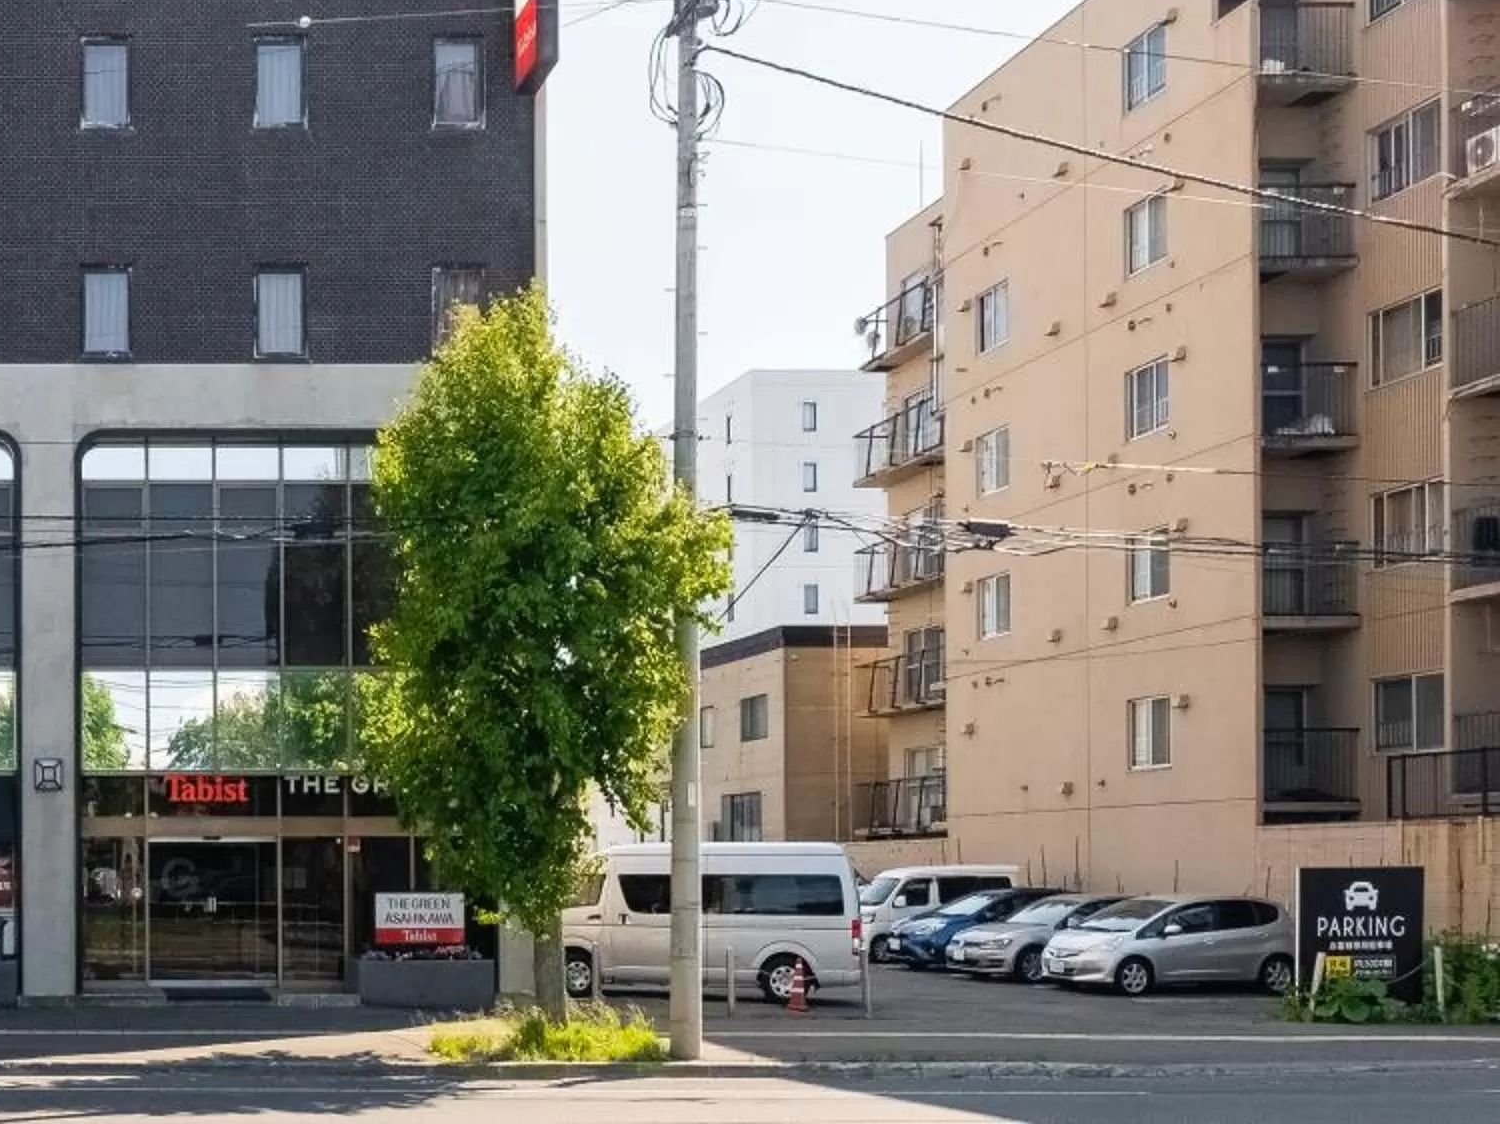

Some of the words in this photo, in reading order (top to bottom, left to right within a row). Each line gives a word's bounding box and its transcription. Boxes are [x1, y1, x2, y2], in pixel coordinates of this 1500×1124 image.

[165, 773, 250, 802] Tabist
[284, 775, 340, 795] THE
[387, 897, 410, 910] THE
[412, 897, 451, 910] GREEN
[384, 911, 455, 925] ASAHIKAWA
[1317, 915, 1406, 937] PARKING
[401, 930, 438, 941] Tabist
